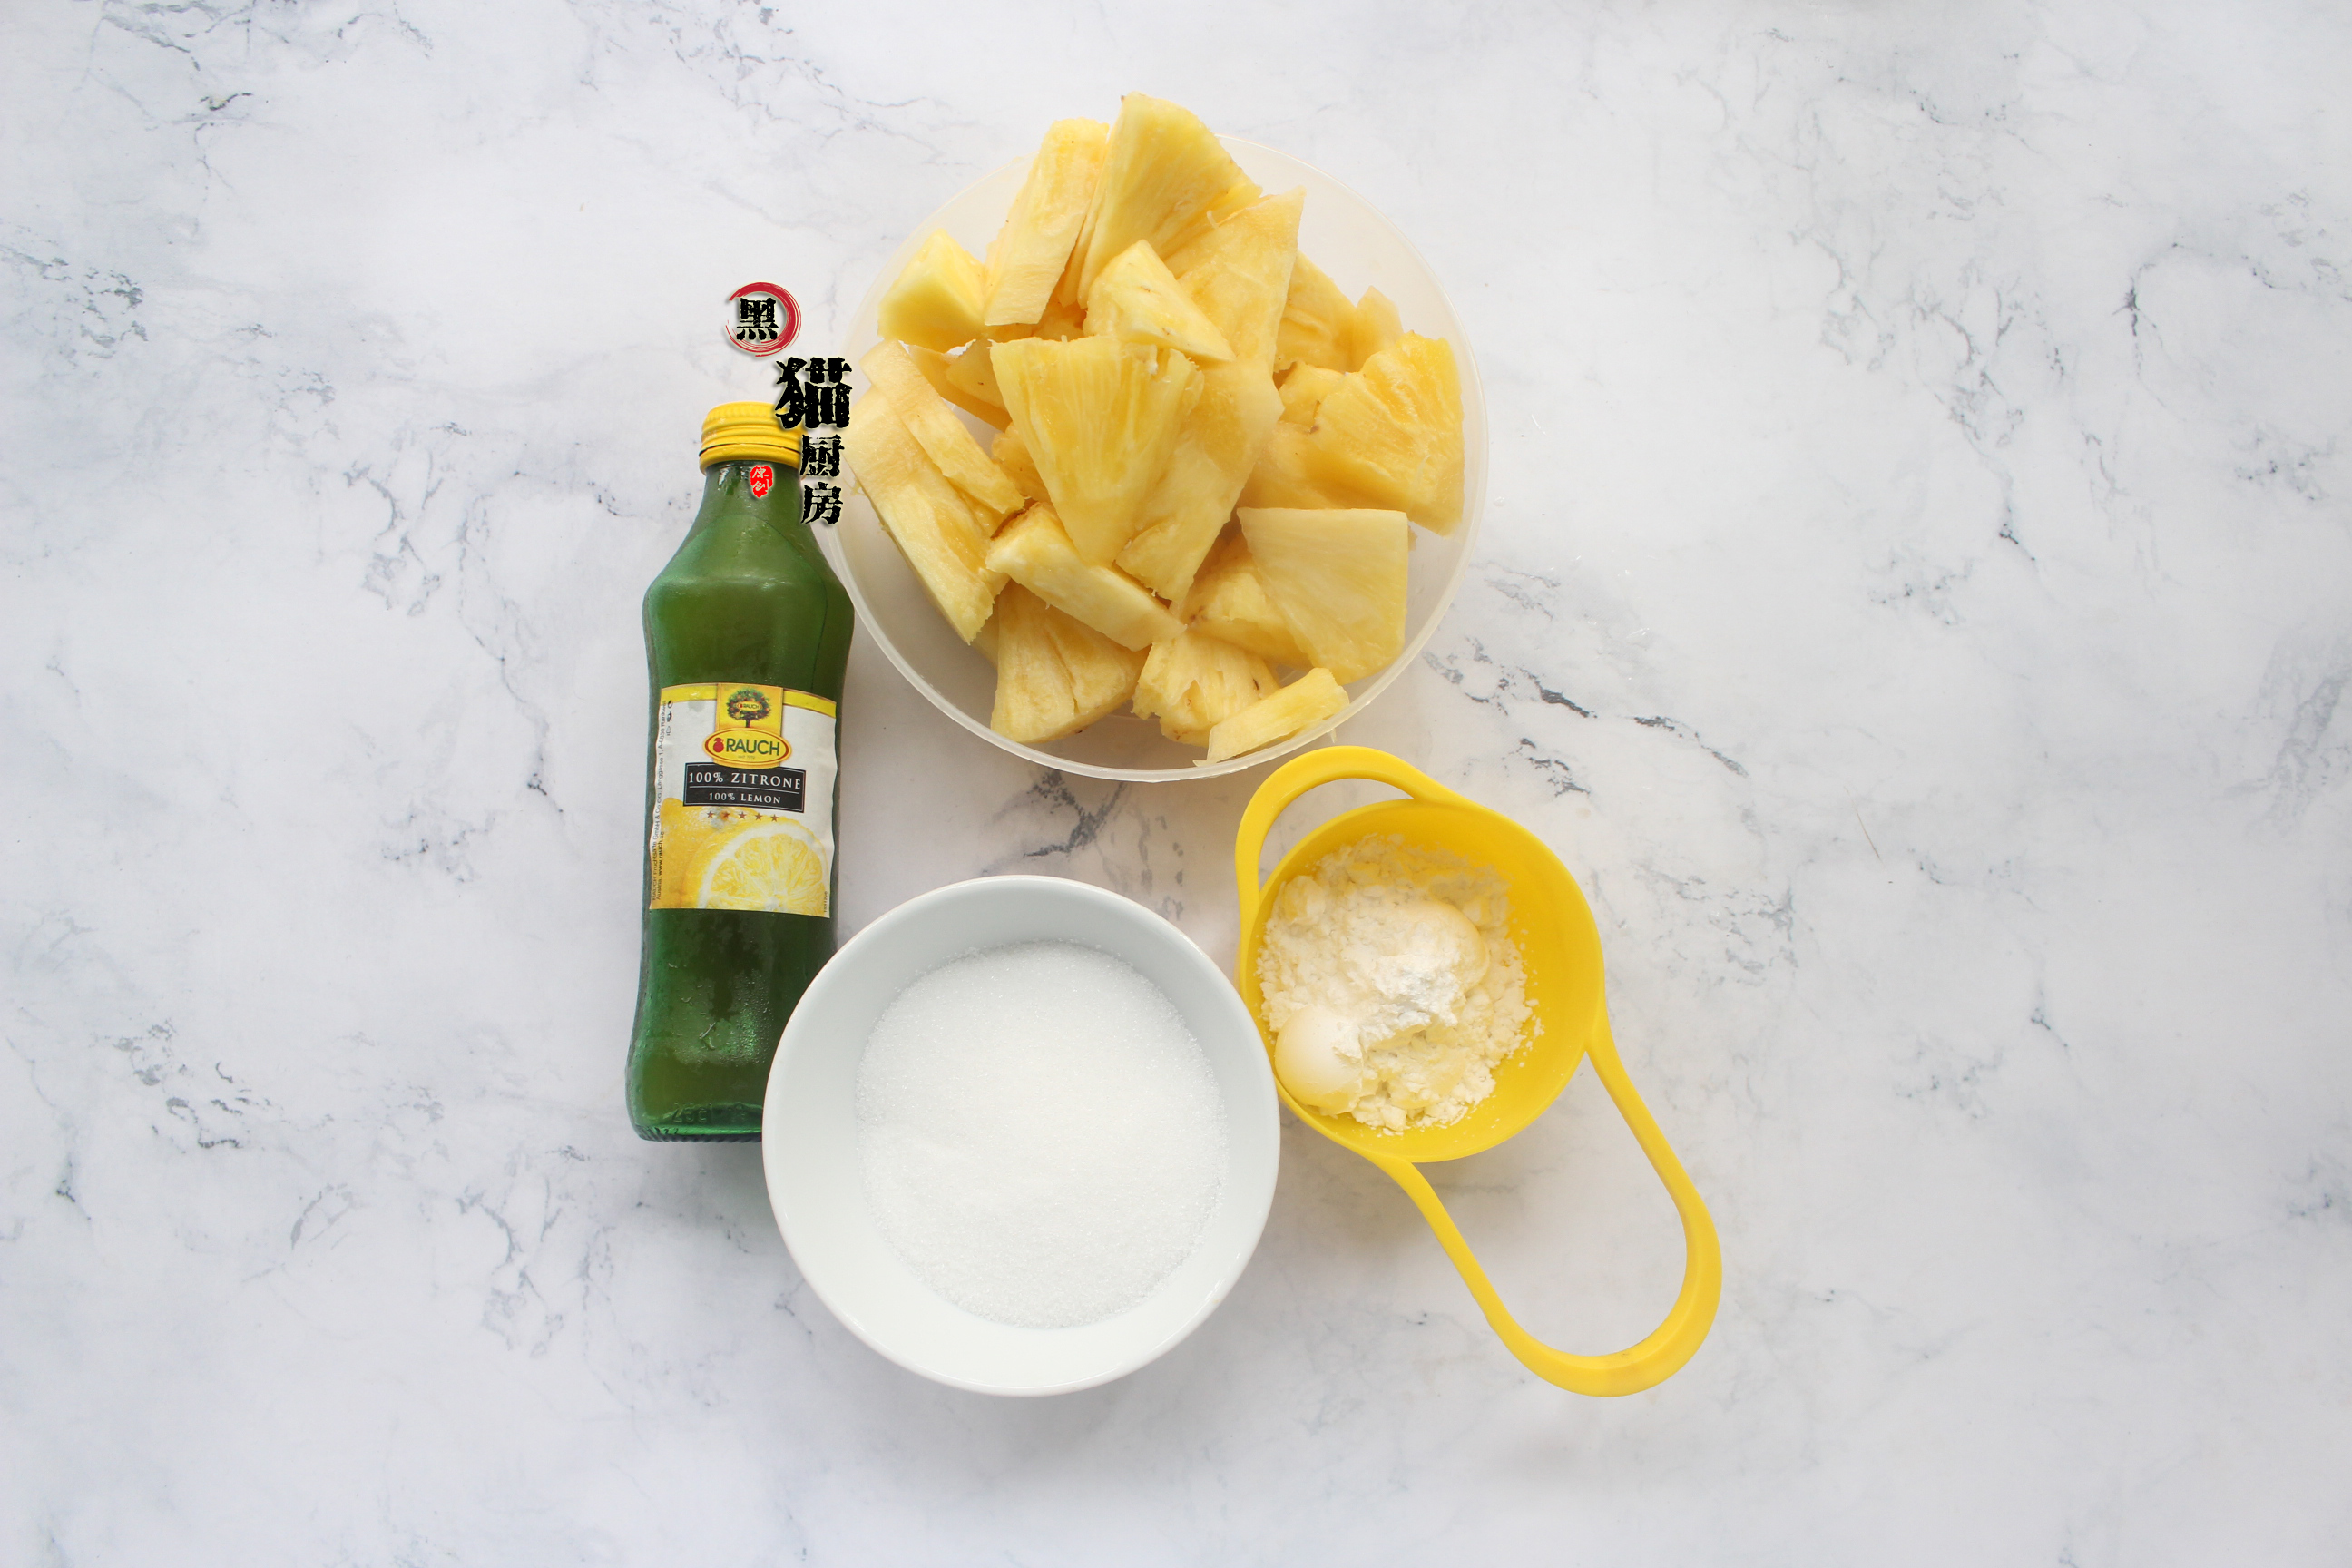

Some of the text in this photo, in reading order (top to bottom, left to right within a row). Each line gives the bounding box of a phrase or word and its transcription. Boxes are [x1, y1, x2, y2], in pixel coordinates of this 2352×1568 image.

[725, 738, 780, 756] RAUCH
[688, 771, 801, 789] 100% ZITRONE
[709, 792, 781, 805] 100% LEMON
